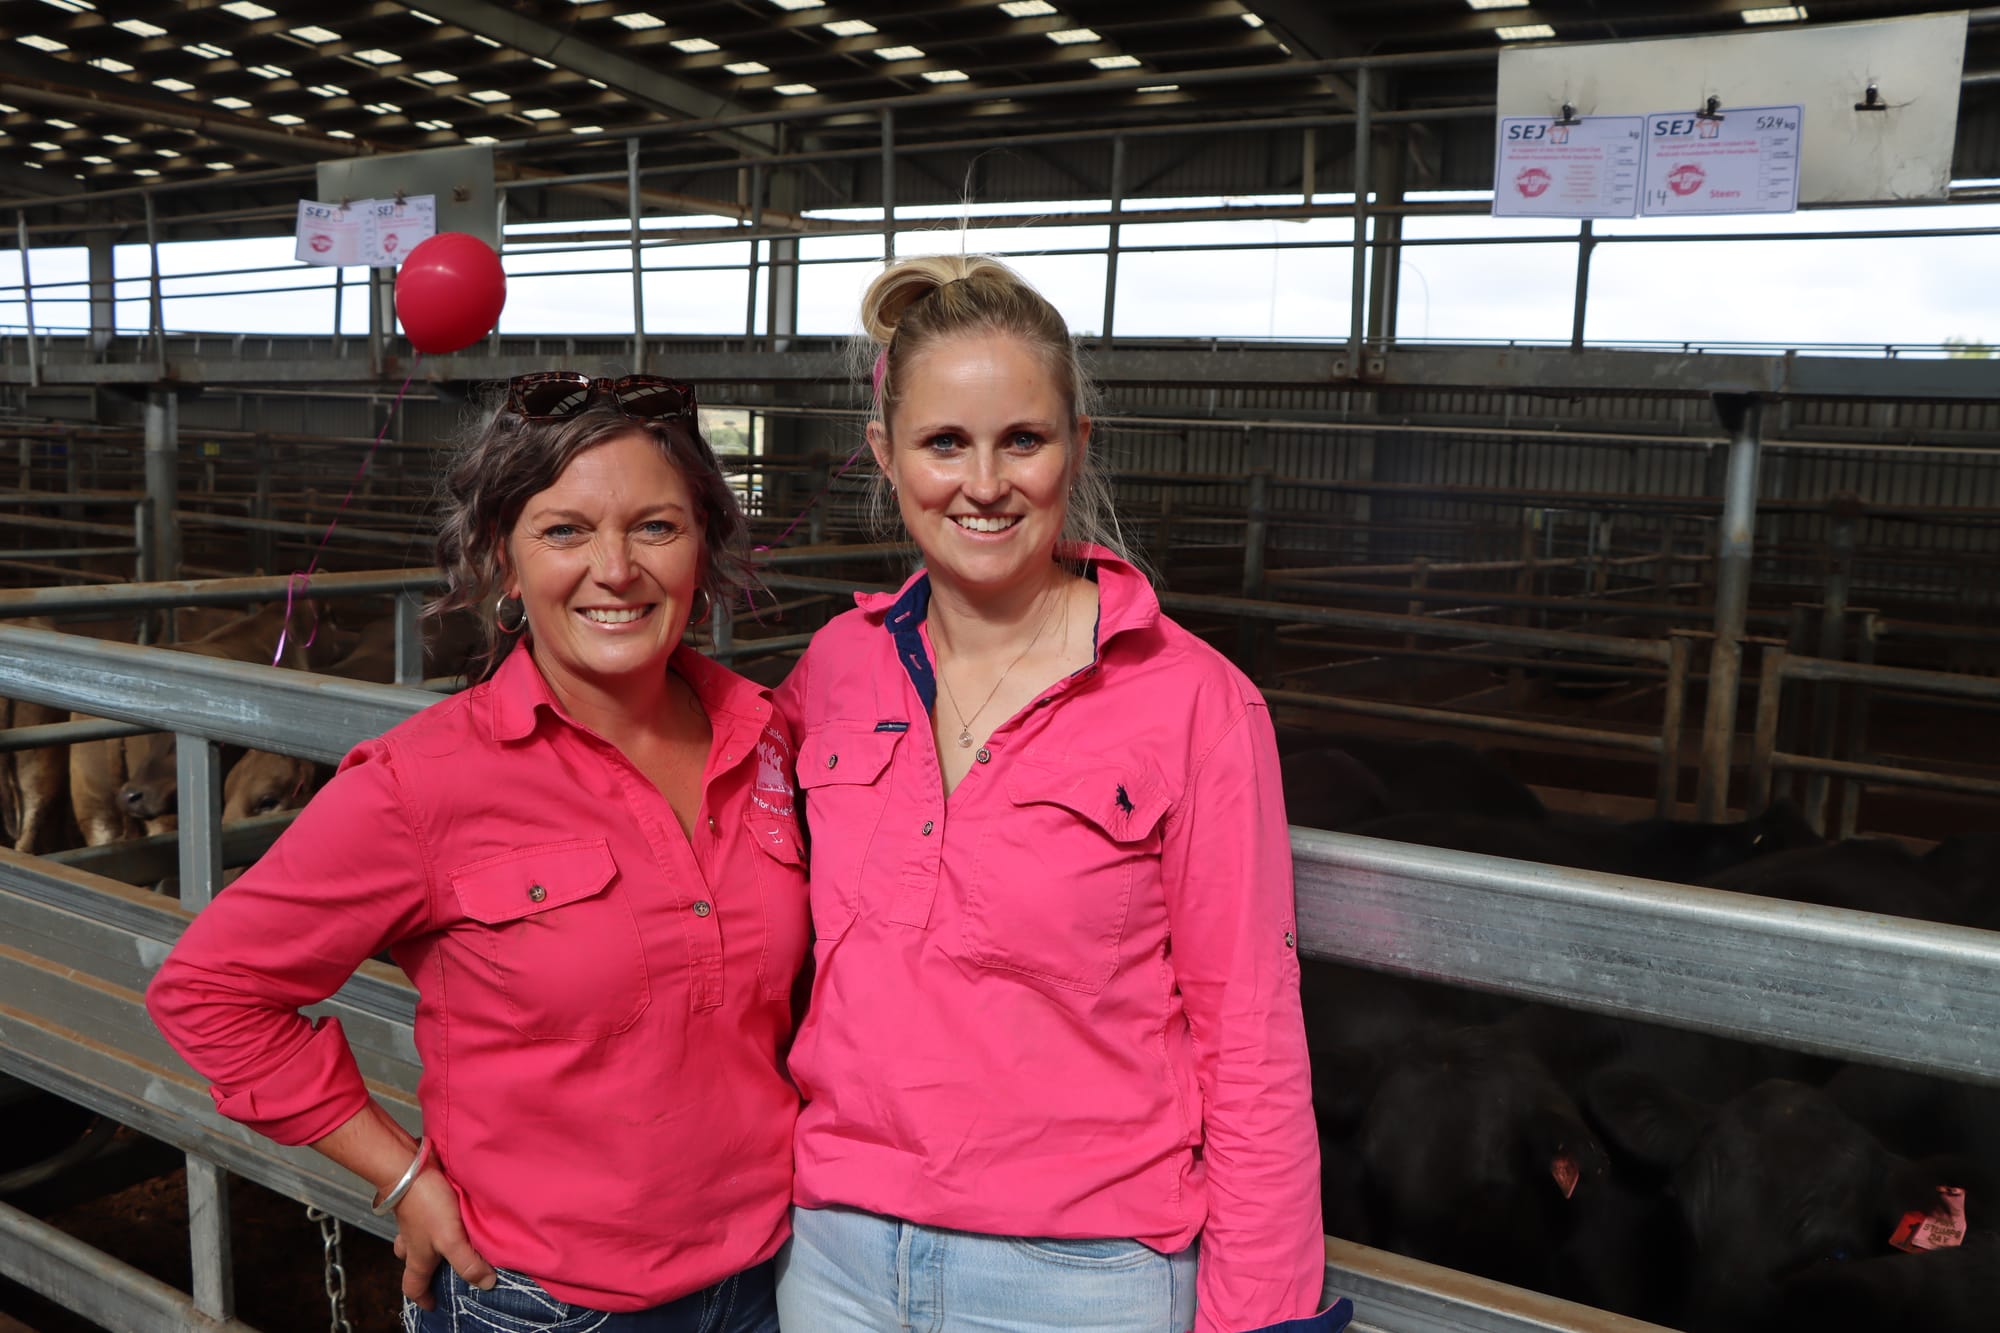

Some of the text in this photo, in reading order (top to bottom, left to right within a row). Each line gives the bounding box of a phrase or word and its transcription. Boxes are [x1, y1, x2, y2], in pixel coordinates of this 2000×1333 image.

[1507, 124, 1546, 140] SEJ
[1654, 120, 1696, 136] SEJ
[1629, 130, 1640, 139] kg
[1709, 189, 1741, 199] Steers
[305, 206, 331, 219] SEJ
[377, 205, 394, 217] SEJ
